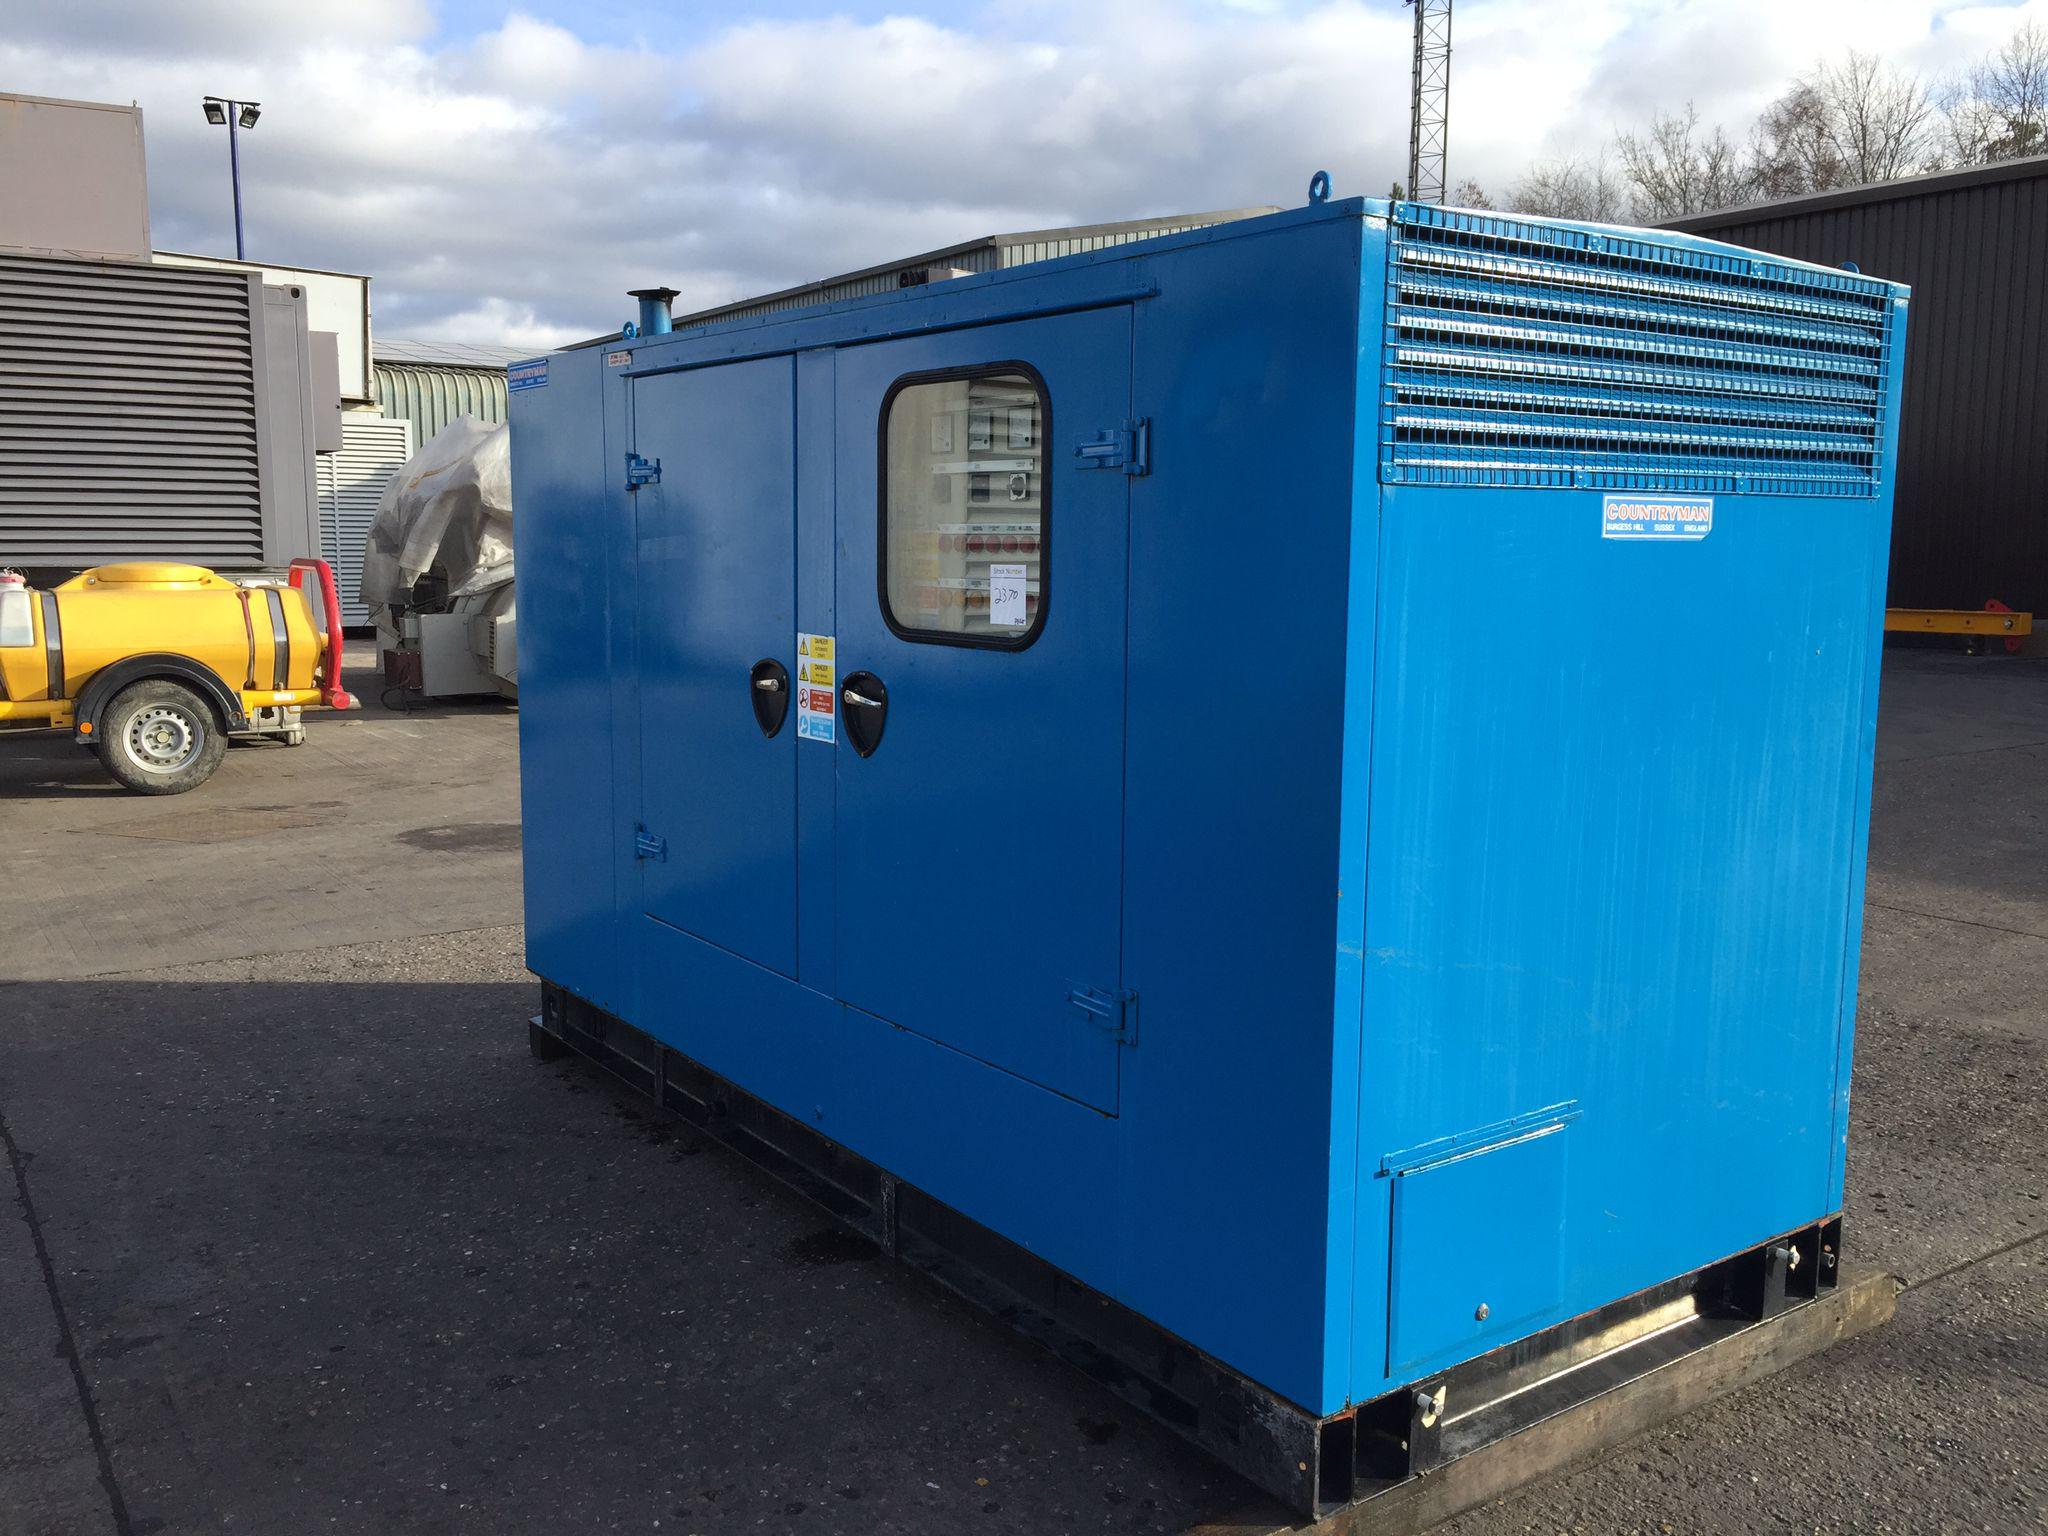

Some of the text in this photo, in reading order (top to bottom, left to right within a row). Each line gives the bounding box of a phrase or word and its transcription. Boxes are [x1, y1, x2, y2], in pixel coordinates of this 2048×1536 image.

[509, 366, 547, 381] COUNTRYMAN
[1608, 504, 1709, 522] COUNTRYMAN
[1606, 523, 1632, 531] BURGESS
[1633, 523, 1644, 531] HILL
[1654, 524, 1675, 532] SUSSEX
[993, 567, 1023, 575] Stock Number
[994, 587, 1019, 605] 2370
